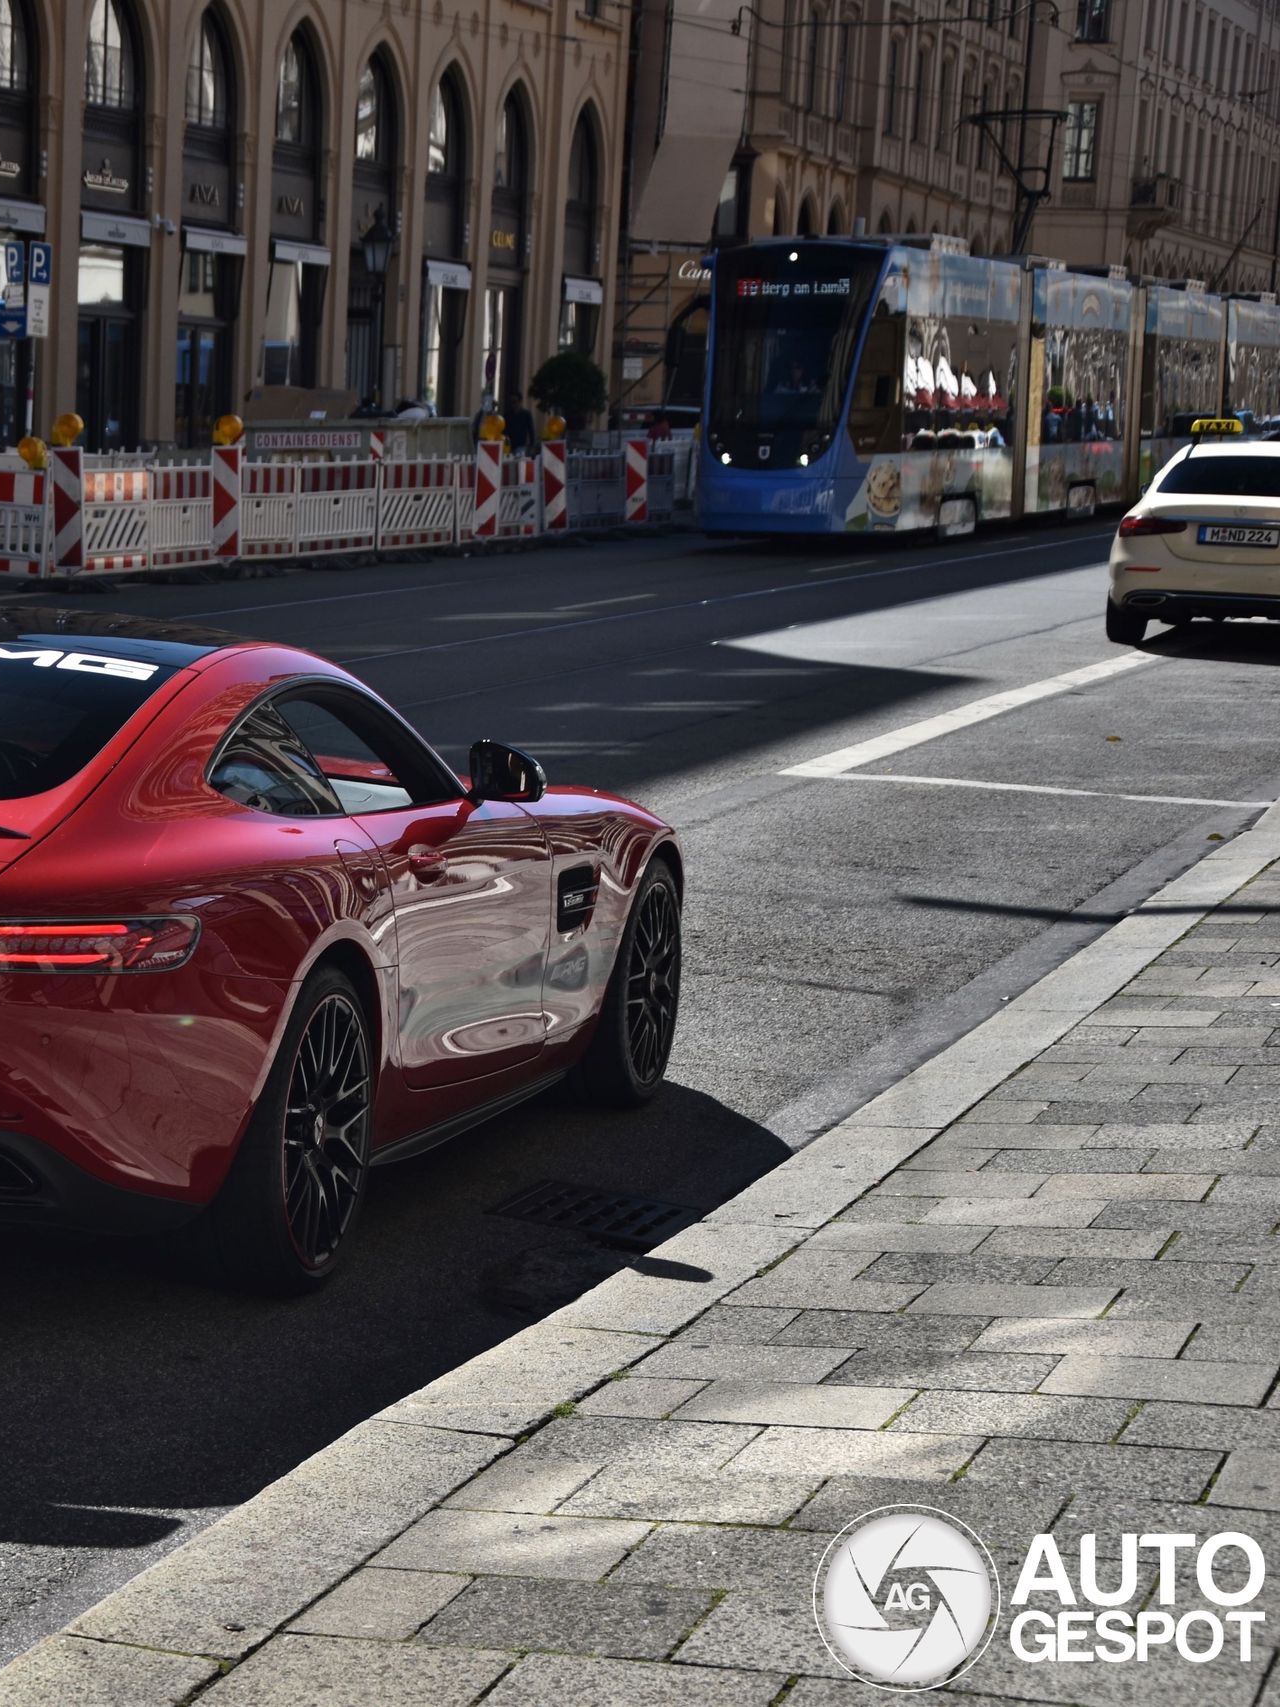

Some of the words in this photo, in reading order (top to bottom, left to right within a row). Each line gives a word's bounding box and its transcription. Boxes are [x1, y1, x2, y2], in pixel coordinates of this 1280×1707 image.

[492, 230, 515, 251] CELINE
[7, 246, 19, 279] P
[31, 247, 46, 279] P
[762, 281, 790, 297] Berg
[794, 283, 810, 295] am
[814, 280, 839, 295] Laim
[1200, 421, 1234, 431] TAXI
[256, 433, 359, 447] CONTAINERDIENST
[24, 513, 40, 523] WH
[1210, 529, 1220, 541] M
[1228, 530, 1246, 543] ND
[1248, 531, 1272, 543] 224
